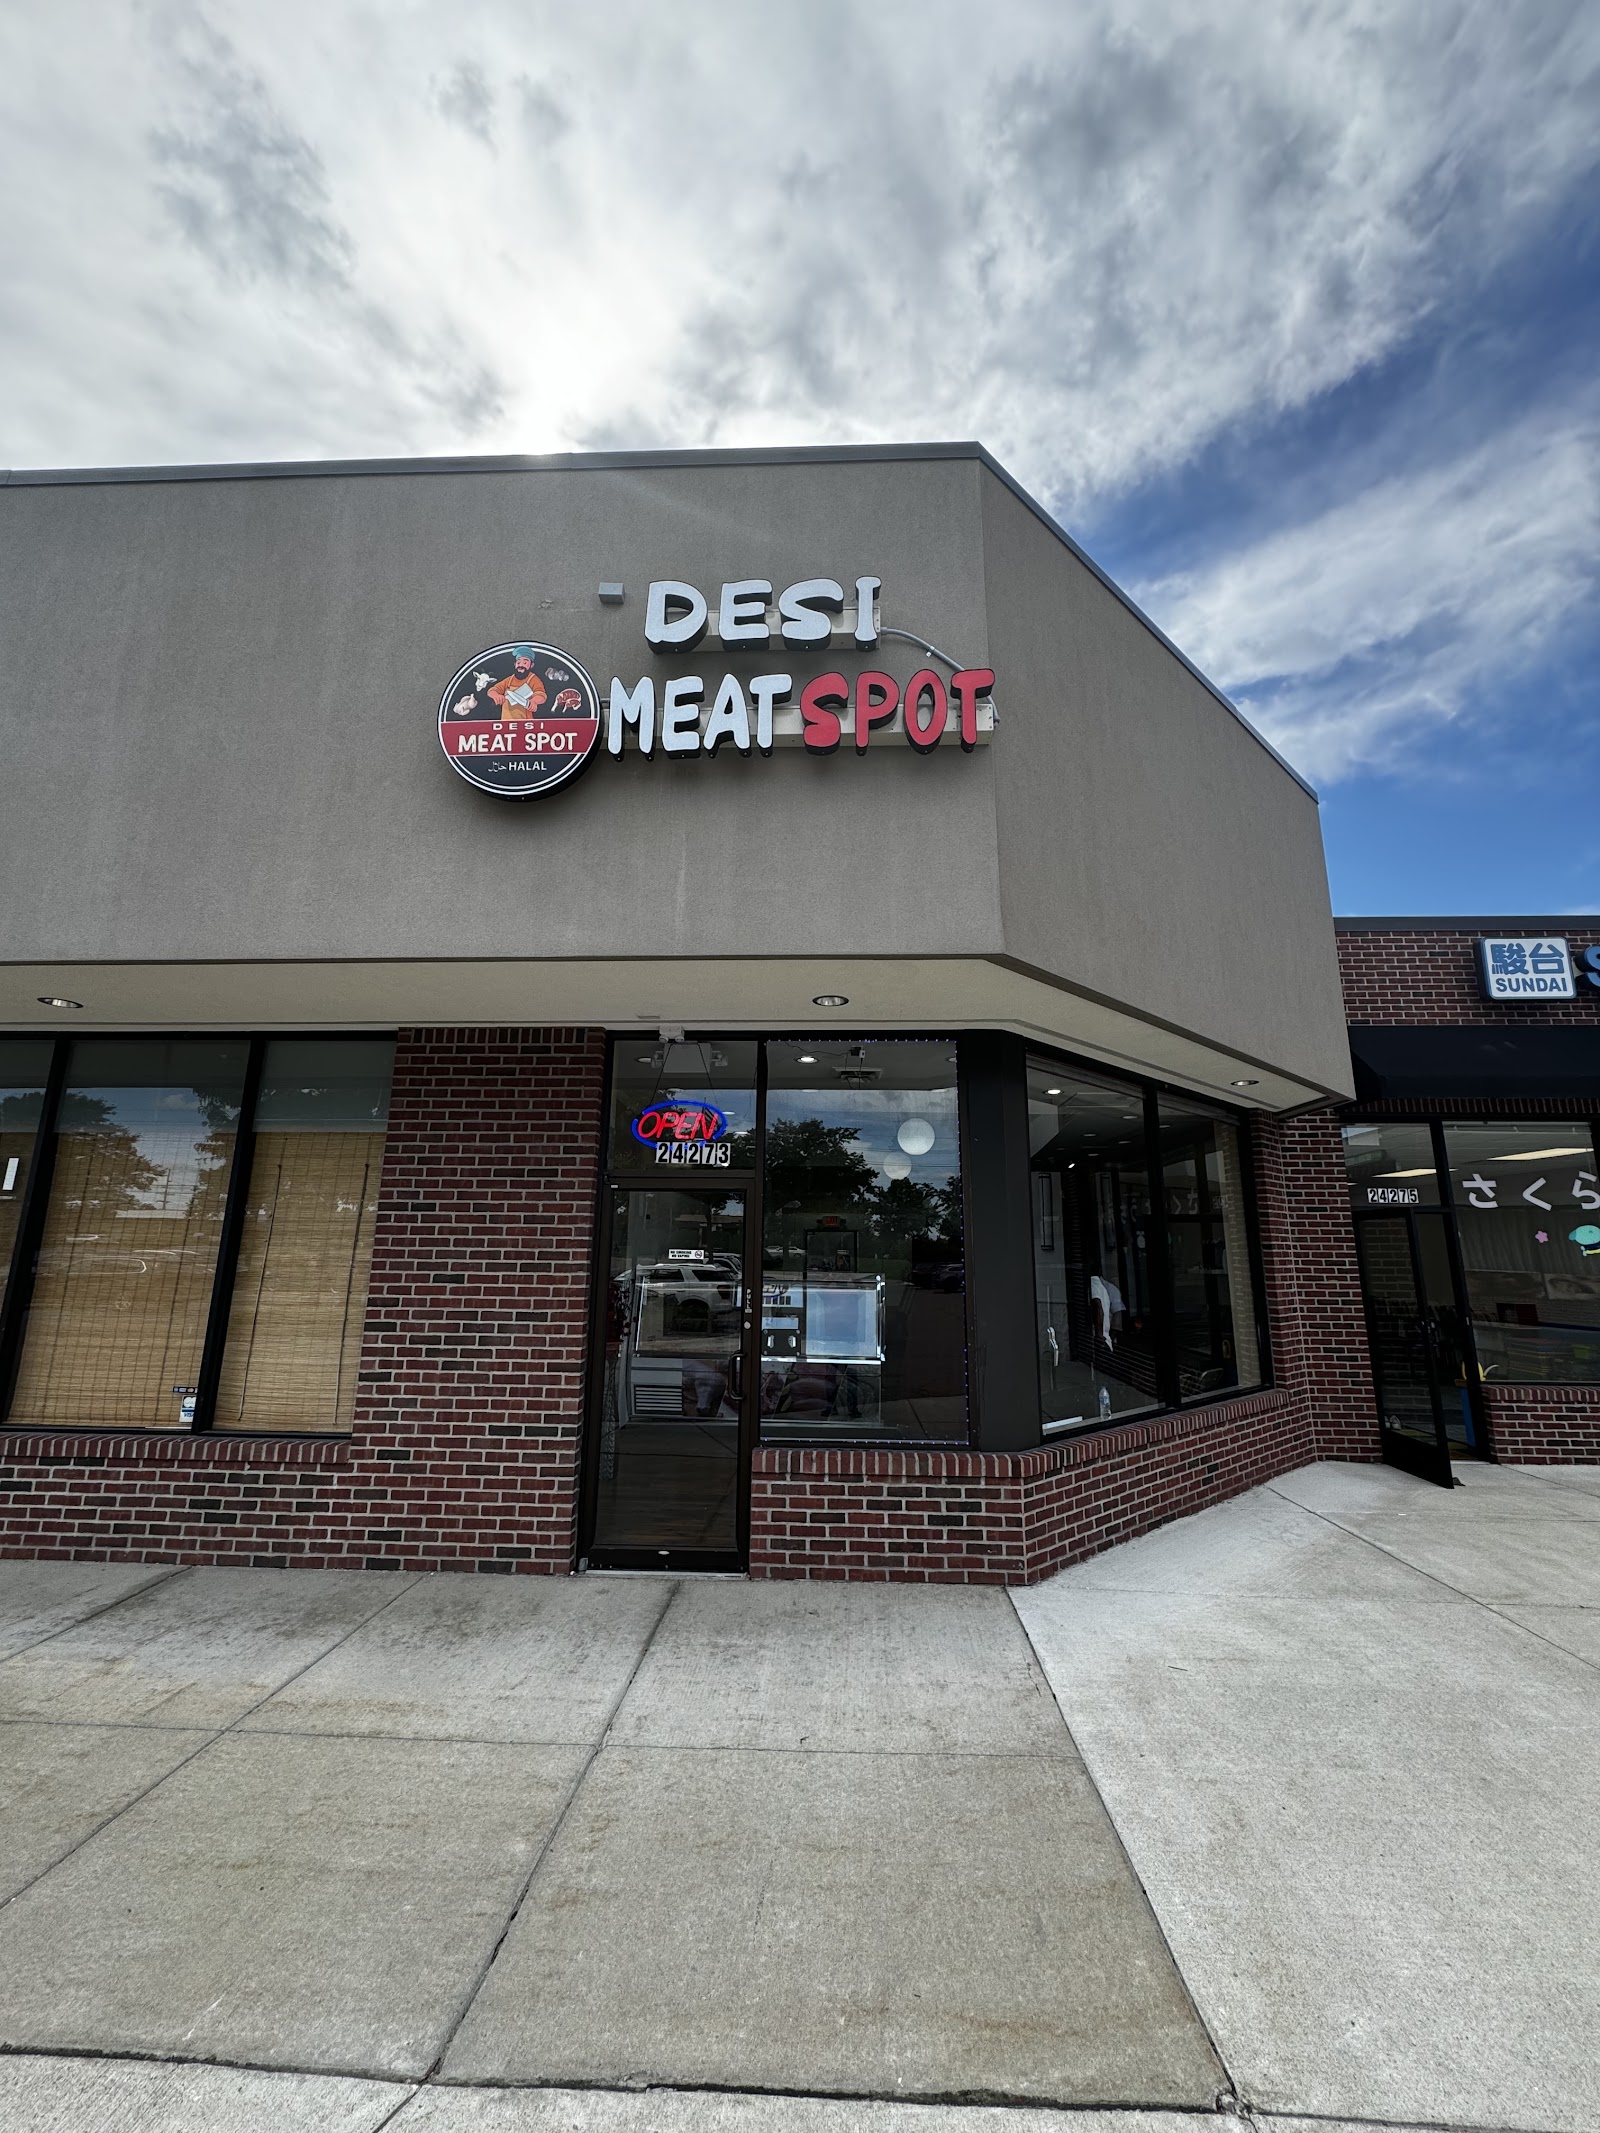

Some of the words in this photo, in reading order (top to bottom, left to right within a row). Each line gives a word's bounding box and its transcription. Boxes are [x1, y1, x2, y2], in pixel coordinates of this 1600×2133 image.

[644, 576, 882, 646] DESI
[607, 673, 792, 754] MEAT
[800, 669, 995, 752] SPOT
[493, 722, 544, 731] DESI
[458, 733, 517, 753] MEAT
[524, 732, 578, 751] SPOT
[508, 761, 547, 771] HALAL
[1490, 943, 1564, 975] 駿台
[1495, 977, 1568, 993] SUNDAI
[637, 1111, 718, 1140] OPEN
[657, 1142, 730, 1164] 24273
[1368, 1188, 1418, 1203] 24275
